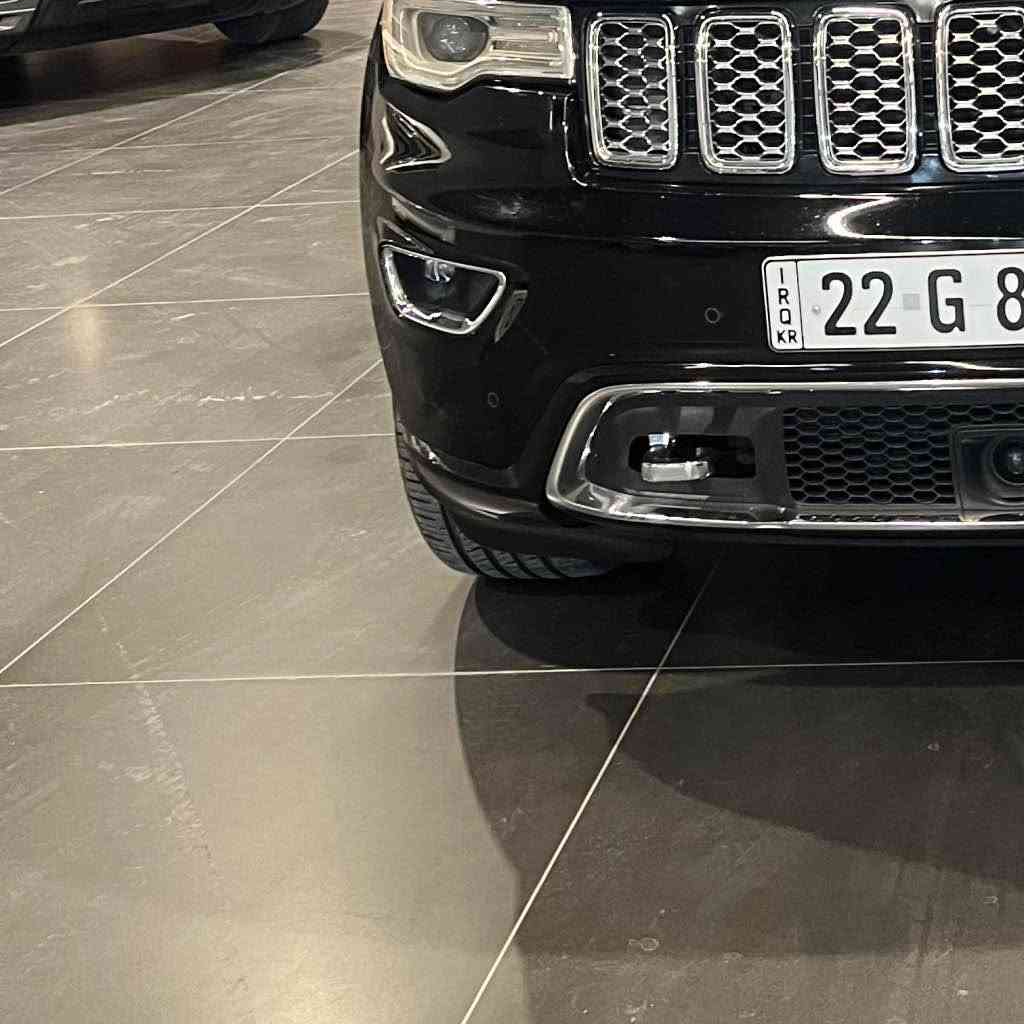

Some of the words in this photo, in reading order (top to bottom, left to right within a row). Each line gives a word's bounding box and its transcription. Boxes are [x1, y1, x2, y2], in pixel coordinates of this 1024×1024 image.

[821, 271, 897, 337] 22
[926, 268, 967, 334] G
[776, 329, 798, 344] KR
